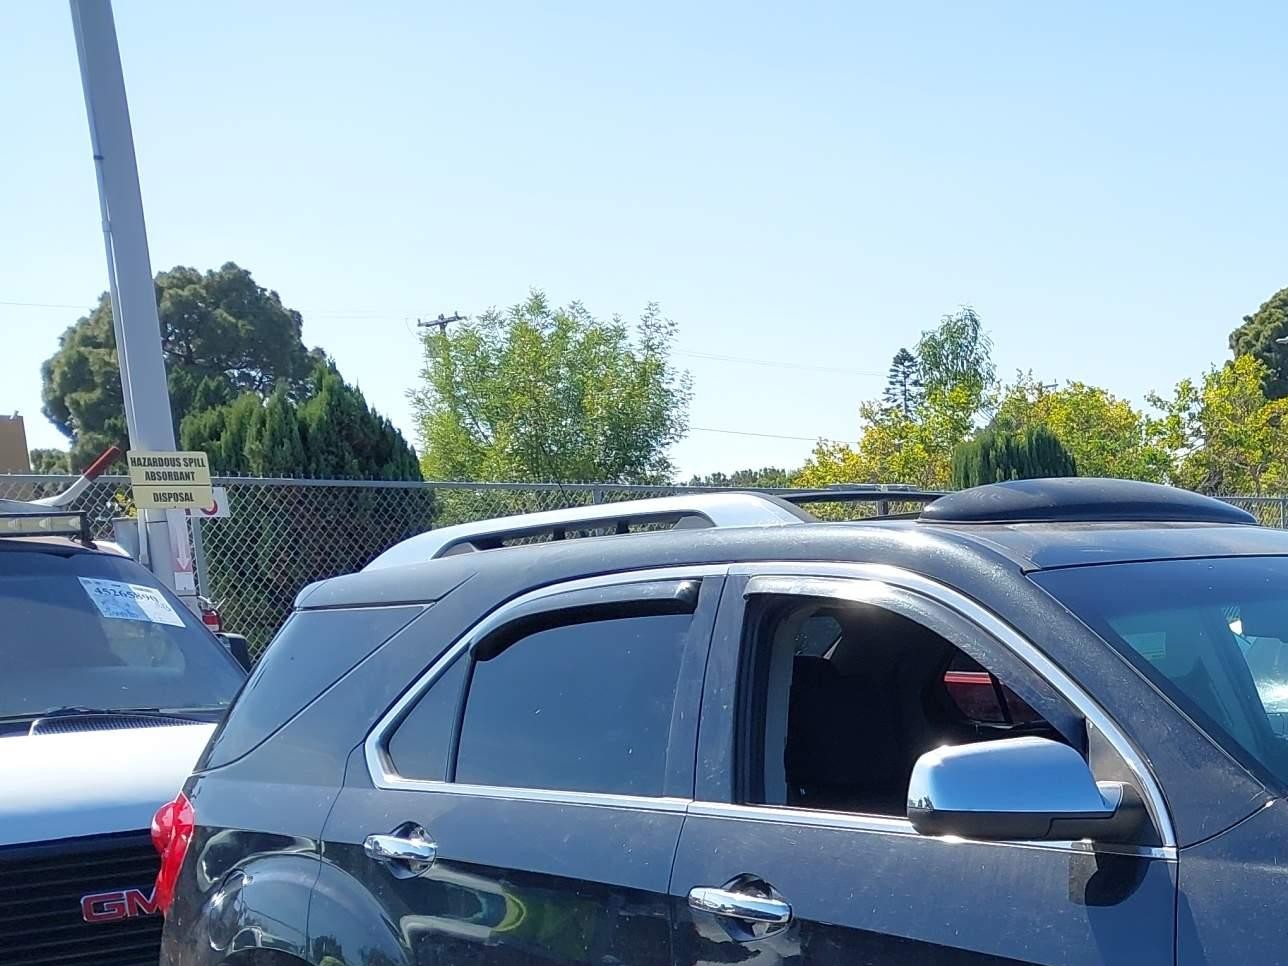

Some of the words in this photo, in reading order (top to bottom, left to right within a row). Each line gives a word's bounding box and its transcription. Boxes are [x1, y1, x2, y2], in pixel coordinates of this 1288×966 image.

[130, 457, 181, 467] HAZARDOUS
[183, 457, 206, 468] SPILL
[152, 492, 194, 502] DISPOSAL
[80, 889, 160, 922] GM
